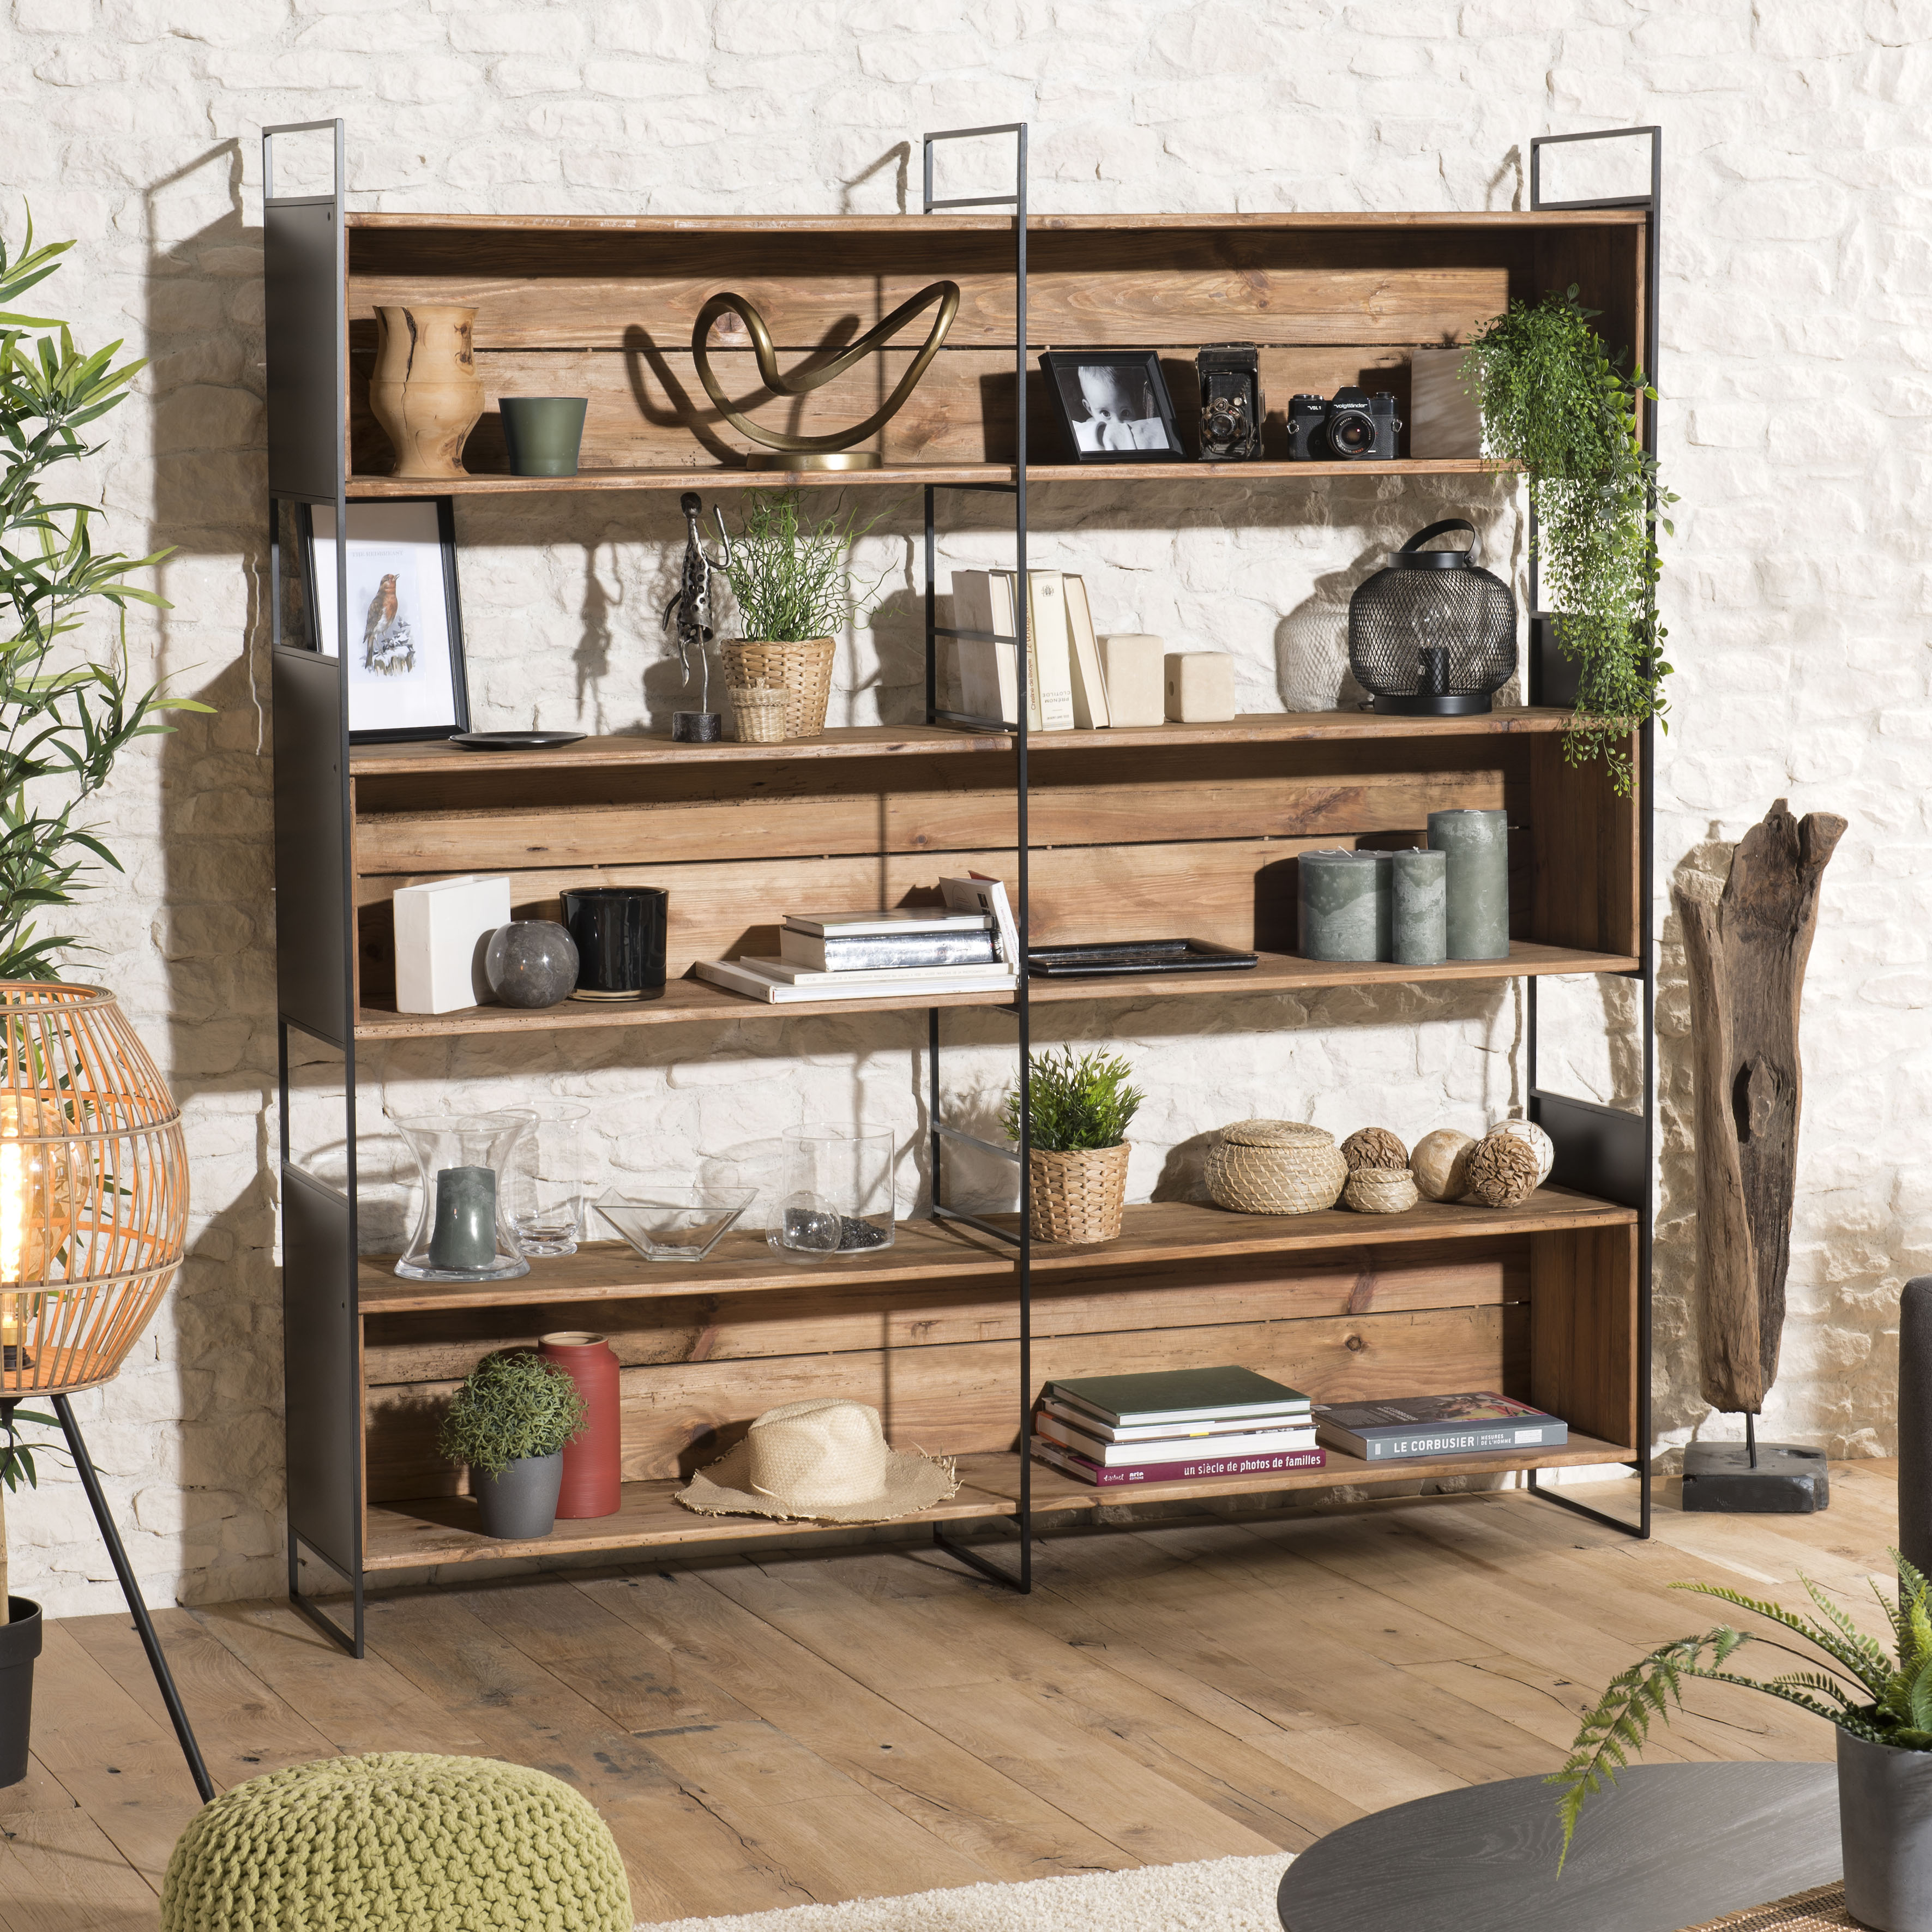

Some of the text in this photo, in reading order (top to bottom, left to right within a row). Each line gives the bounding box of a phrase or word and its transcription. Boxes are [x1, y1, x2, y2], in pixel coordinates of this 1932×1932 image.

[1394, 1436, 1474, 1453] LE CORBUSIER
[1184, 1455, 1321, 1475] un siècle de photos de familles
